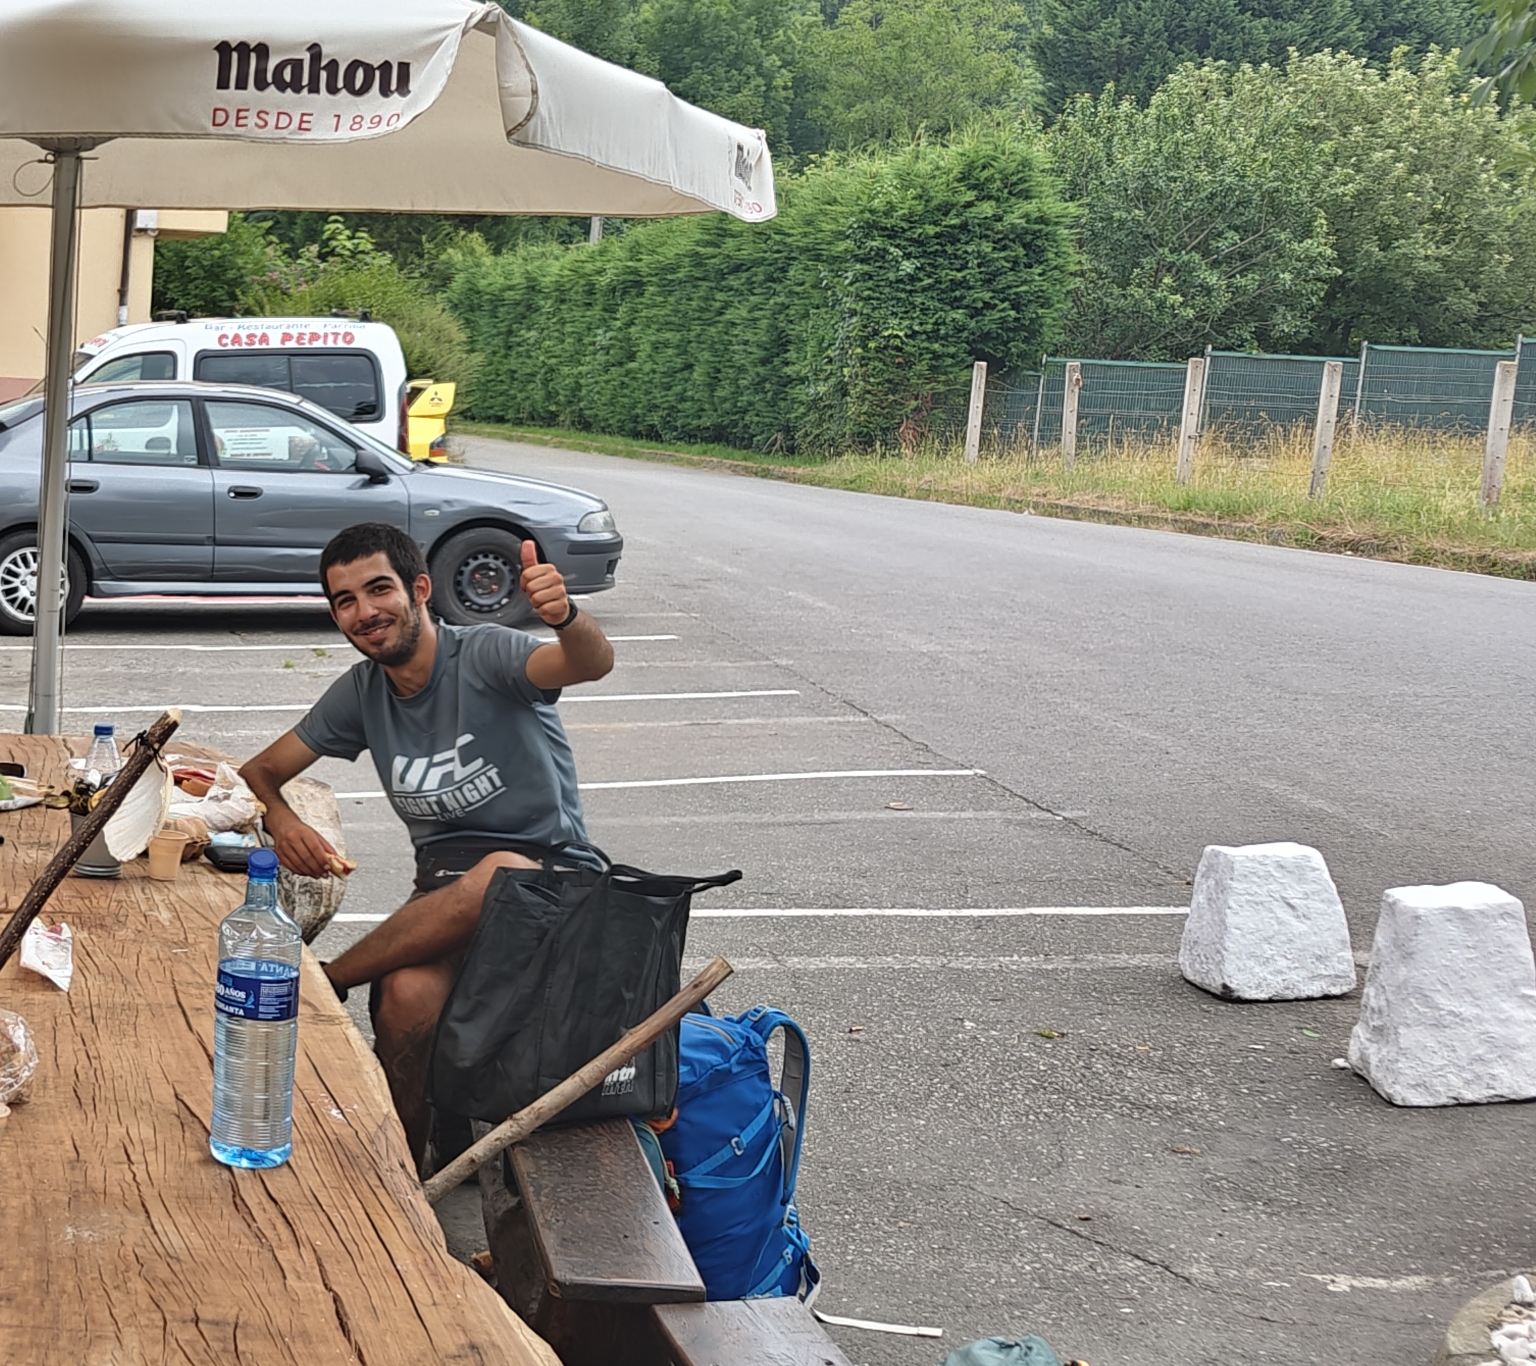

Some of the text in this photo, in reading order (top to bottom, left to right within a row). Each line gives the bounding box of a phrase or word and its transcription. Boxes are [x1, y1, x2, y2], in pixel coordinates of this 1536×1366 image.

[213, 40, 412, 99] Mahou
[211, 108, 401, 133] DESDE 1890
[217, 331, 356, 348] CASA PEPITO
[392, 733, 485, 792] UFC
[441, 767, 504, 812] NIGHT
[436, 808, 466, 822] LIVE
